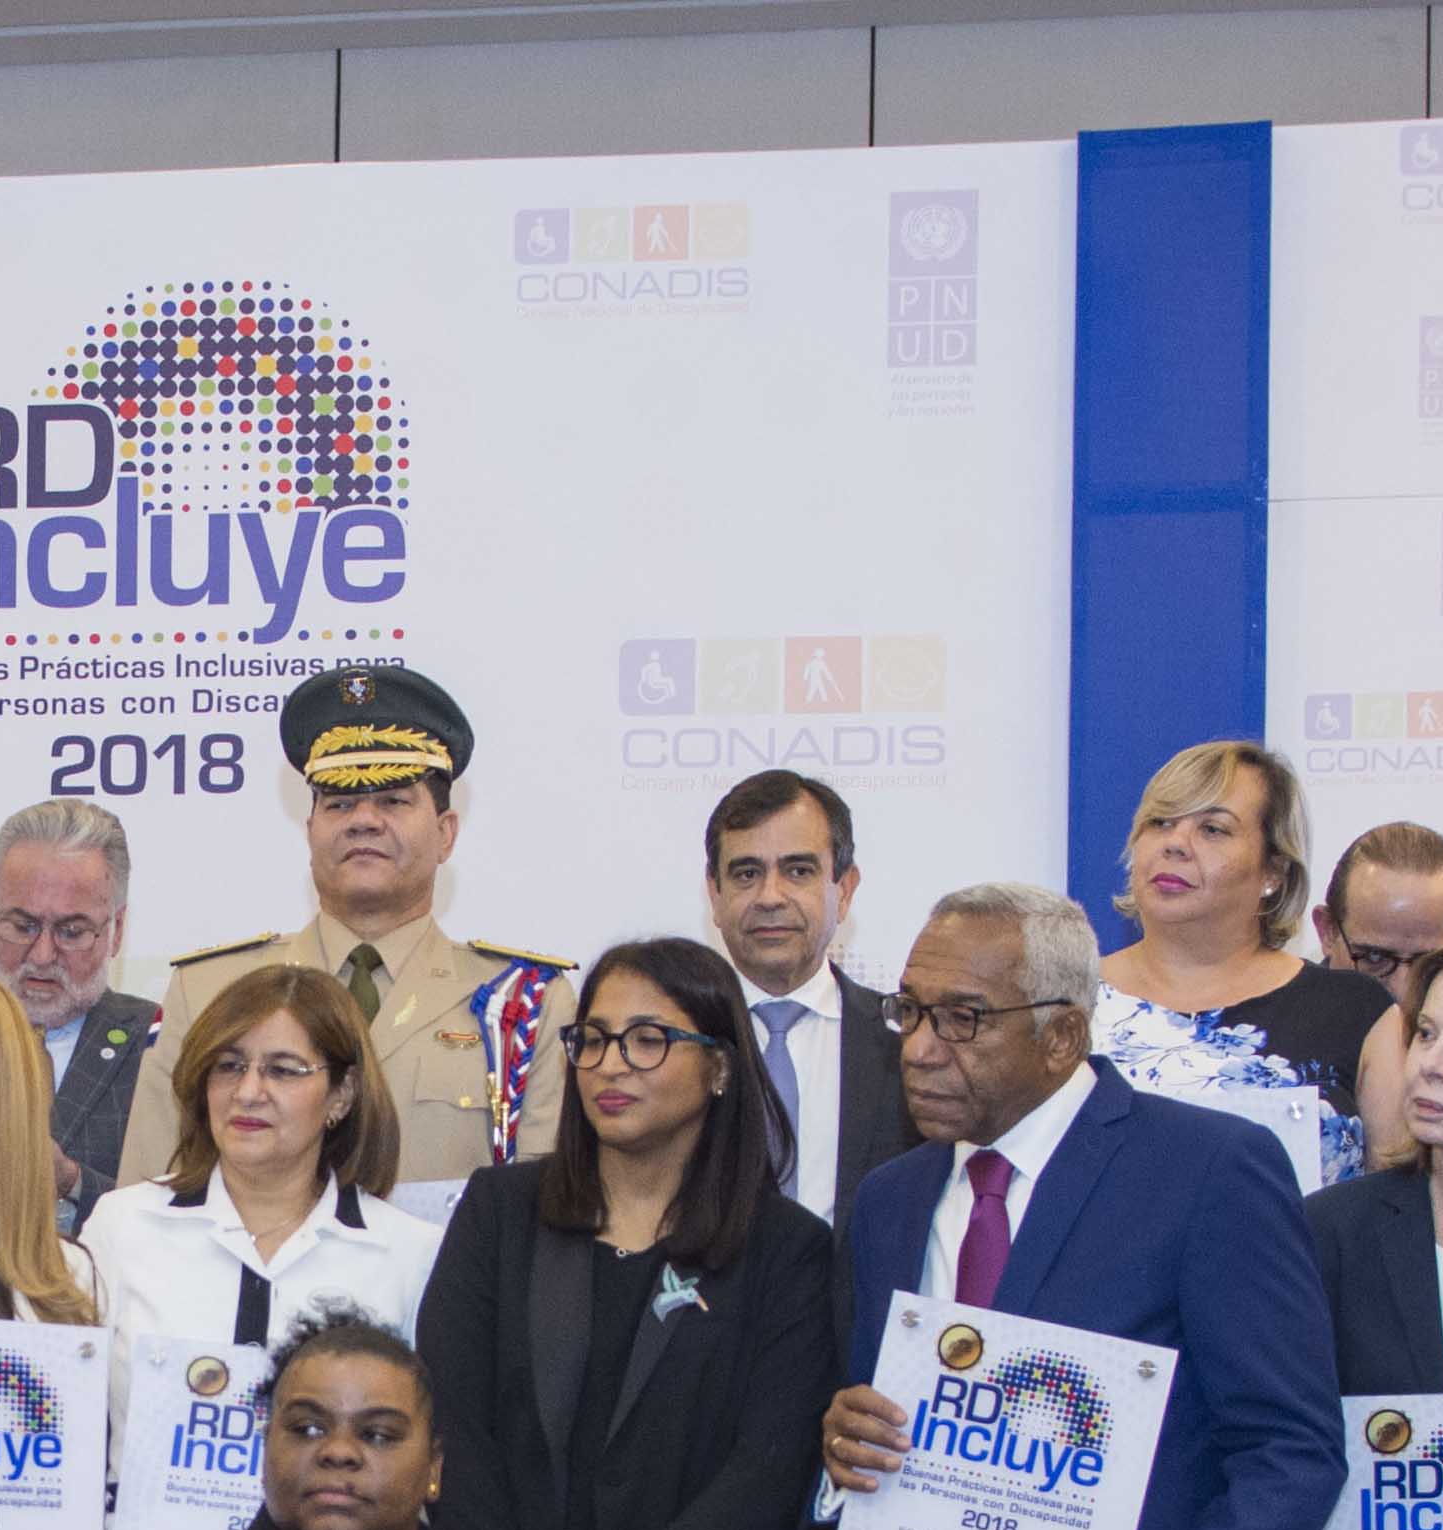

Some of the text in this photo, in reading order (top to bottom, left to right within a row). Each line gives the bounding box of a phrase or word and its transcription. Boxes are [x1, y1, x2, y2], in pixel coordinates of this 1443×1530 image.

[517, 267, 749, 301] CONADIS
[20, 655, 165, 680] Prácticas
[176, 653, 325, 678] Inclusivas
[121, 693, 175, 714] con
[51, 733, 245, 796] 2018
[621, 725, 947, 768] CONADIS
[186, 1401, 255, 1444] RD
[930, 1374, 1004, 1427] RD
[169, 1424, 260, 1476] Incl
[908, 1399, 1105, 1493] Incluye
[902, 1465, 945, 1484] Buenas
[1005, 1489, 1063, 1510] Inclusivas
[1065, 1505, 1093, 1517] para
[1374, 1460, 1443, 1499] RD
[899, 1478, 1091, 1530] las Personas con Discapacidad
